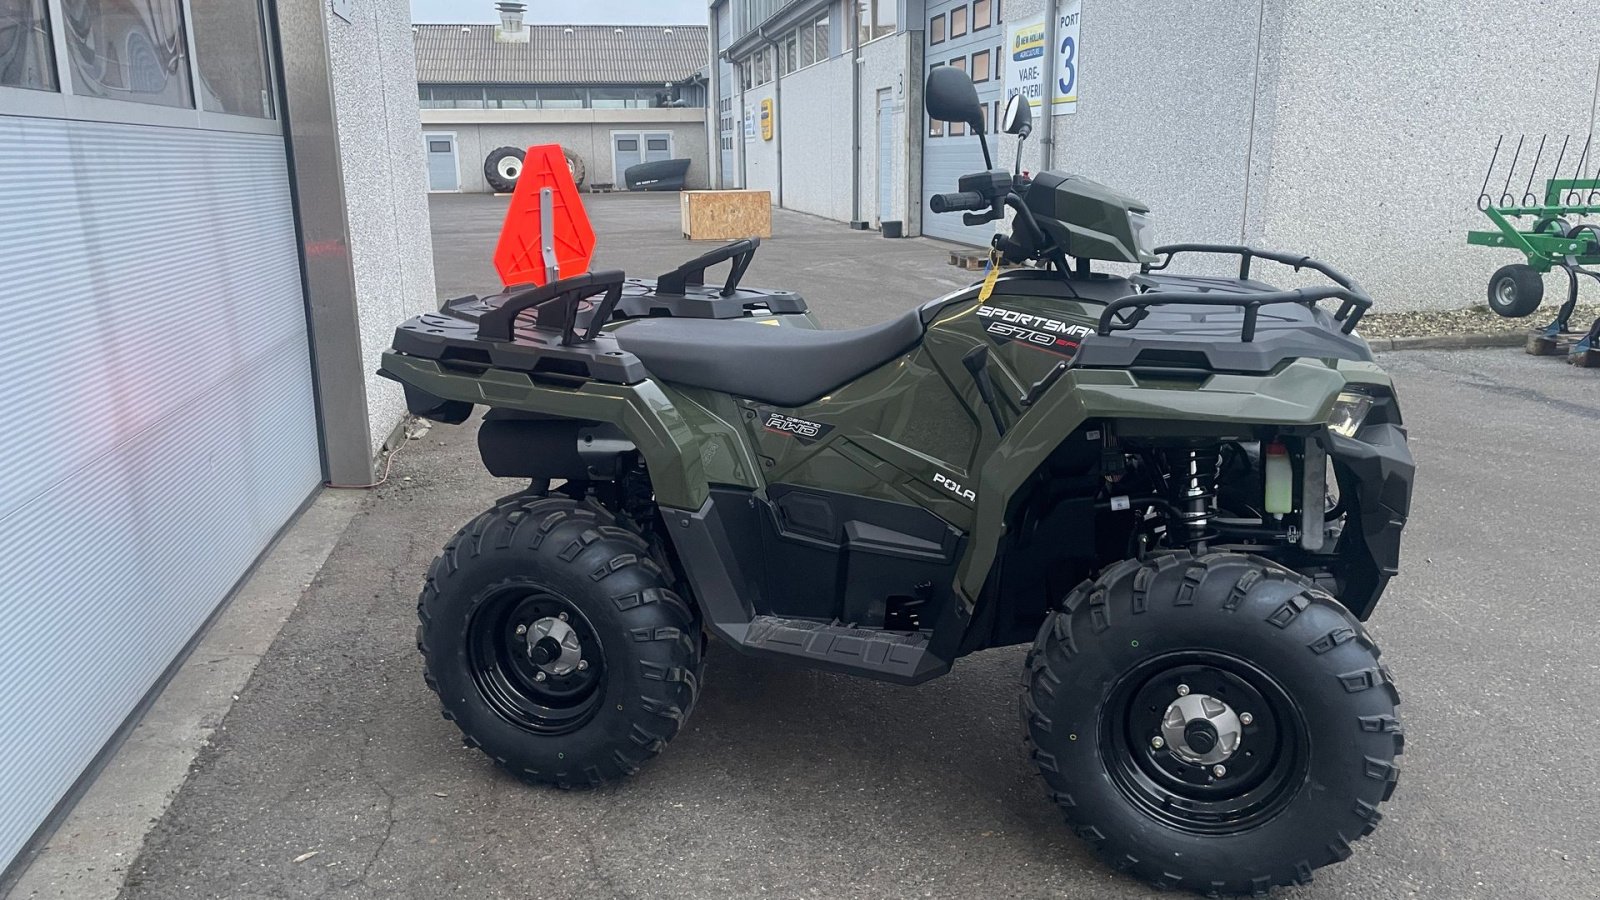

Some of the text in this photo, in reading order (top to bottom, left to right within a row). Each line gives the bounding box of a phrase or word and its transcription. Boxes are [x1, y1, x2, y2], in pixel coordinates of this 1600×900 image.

[1060, 13, 1079, 28] PORT
[1019, 66, 1039, 81] VARE-
[1059, 36, 1075, 94] 3
[898, 73, 903, 94] 3
[986, 321, 1057, 346] 570
[766, 418, 818, 436] AWD
[932, 472, 976, 502] POLA
